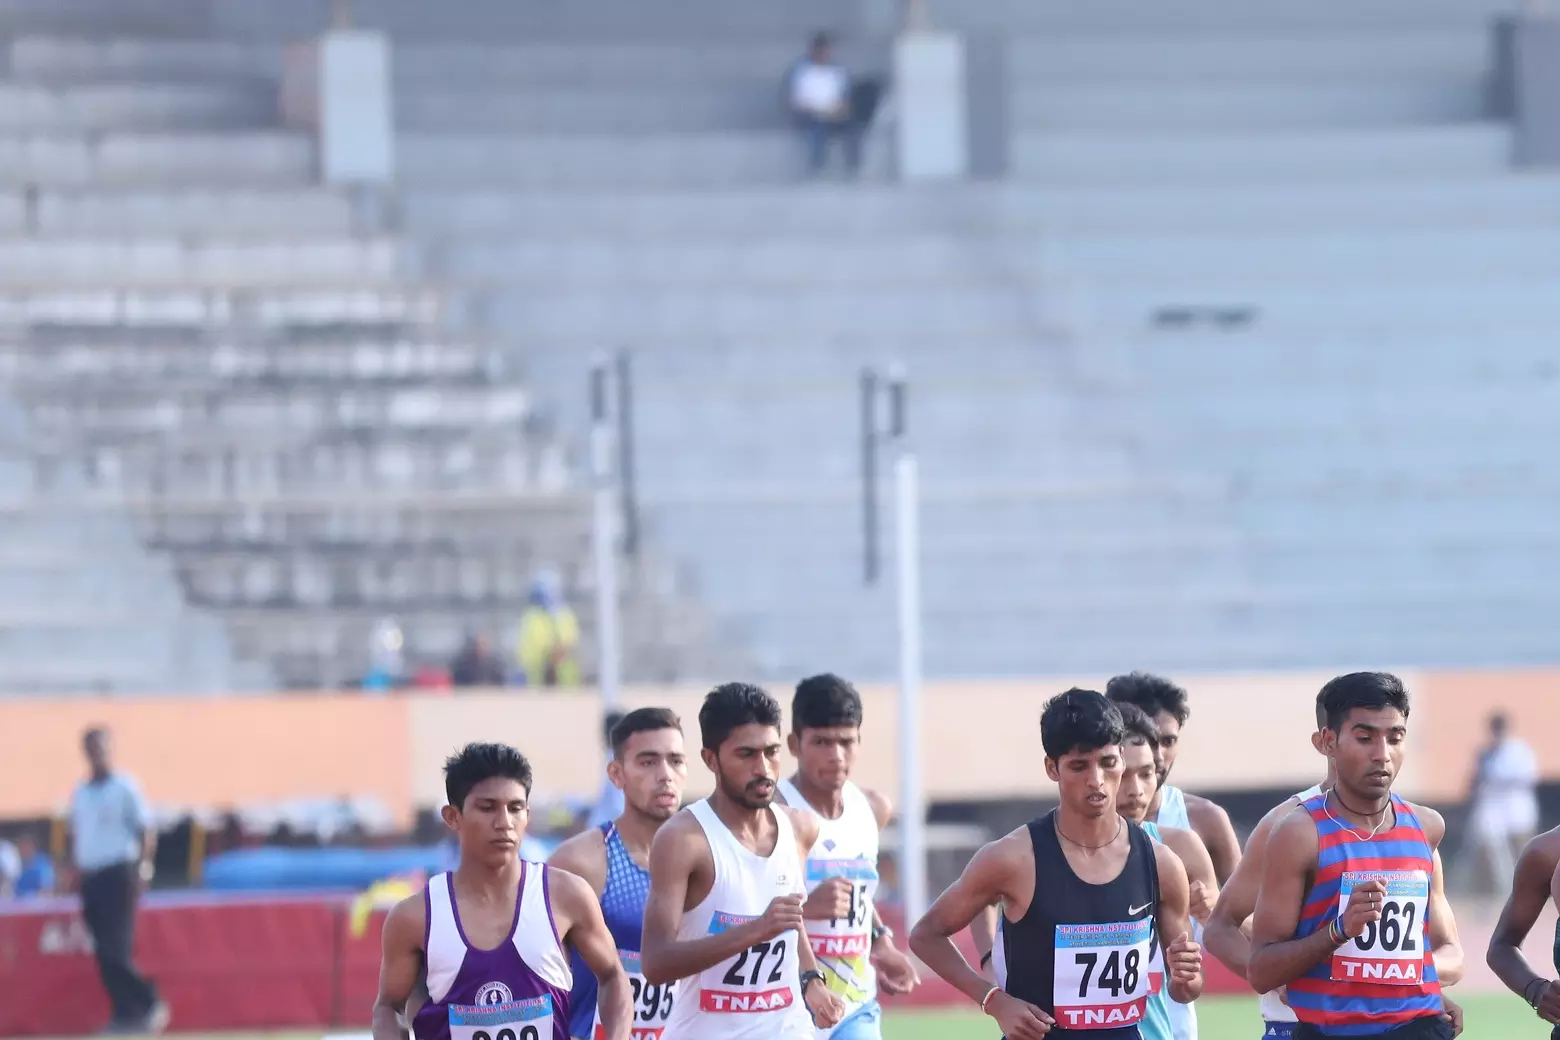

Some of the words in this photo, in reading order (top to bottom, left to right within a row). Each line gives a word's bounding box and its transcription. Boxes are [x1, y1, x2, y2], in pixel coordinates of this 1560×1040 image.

[1074, 924, 1105, 933] KRISHNA
[722, 939, 786, 986] 272
[1341, 961, 1417, 979] TNAA
[1075, 949, 1140, 998] 748
[711, 992, 786, 1011] TNAA
[1064, 1004, 1140, 1025] TNAA
